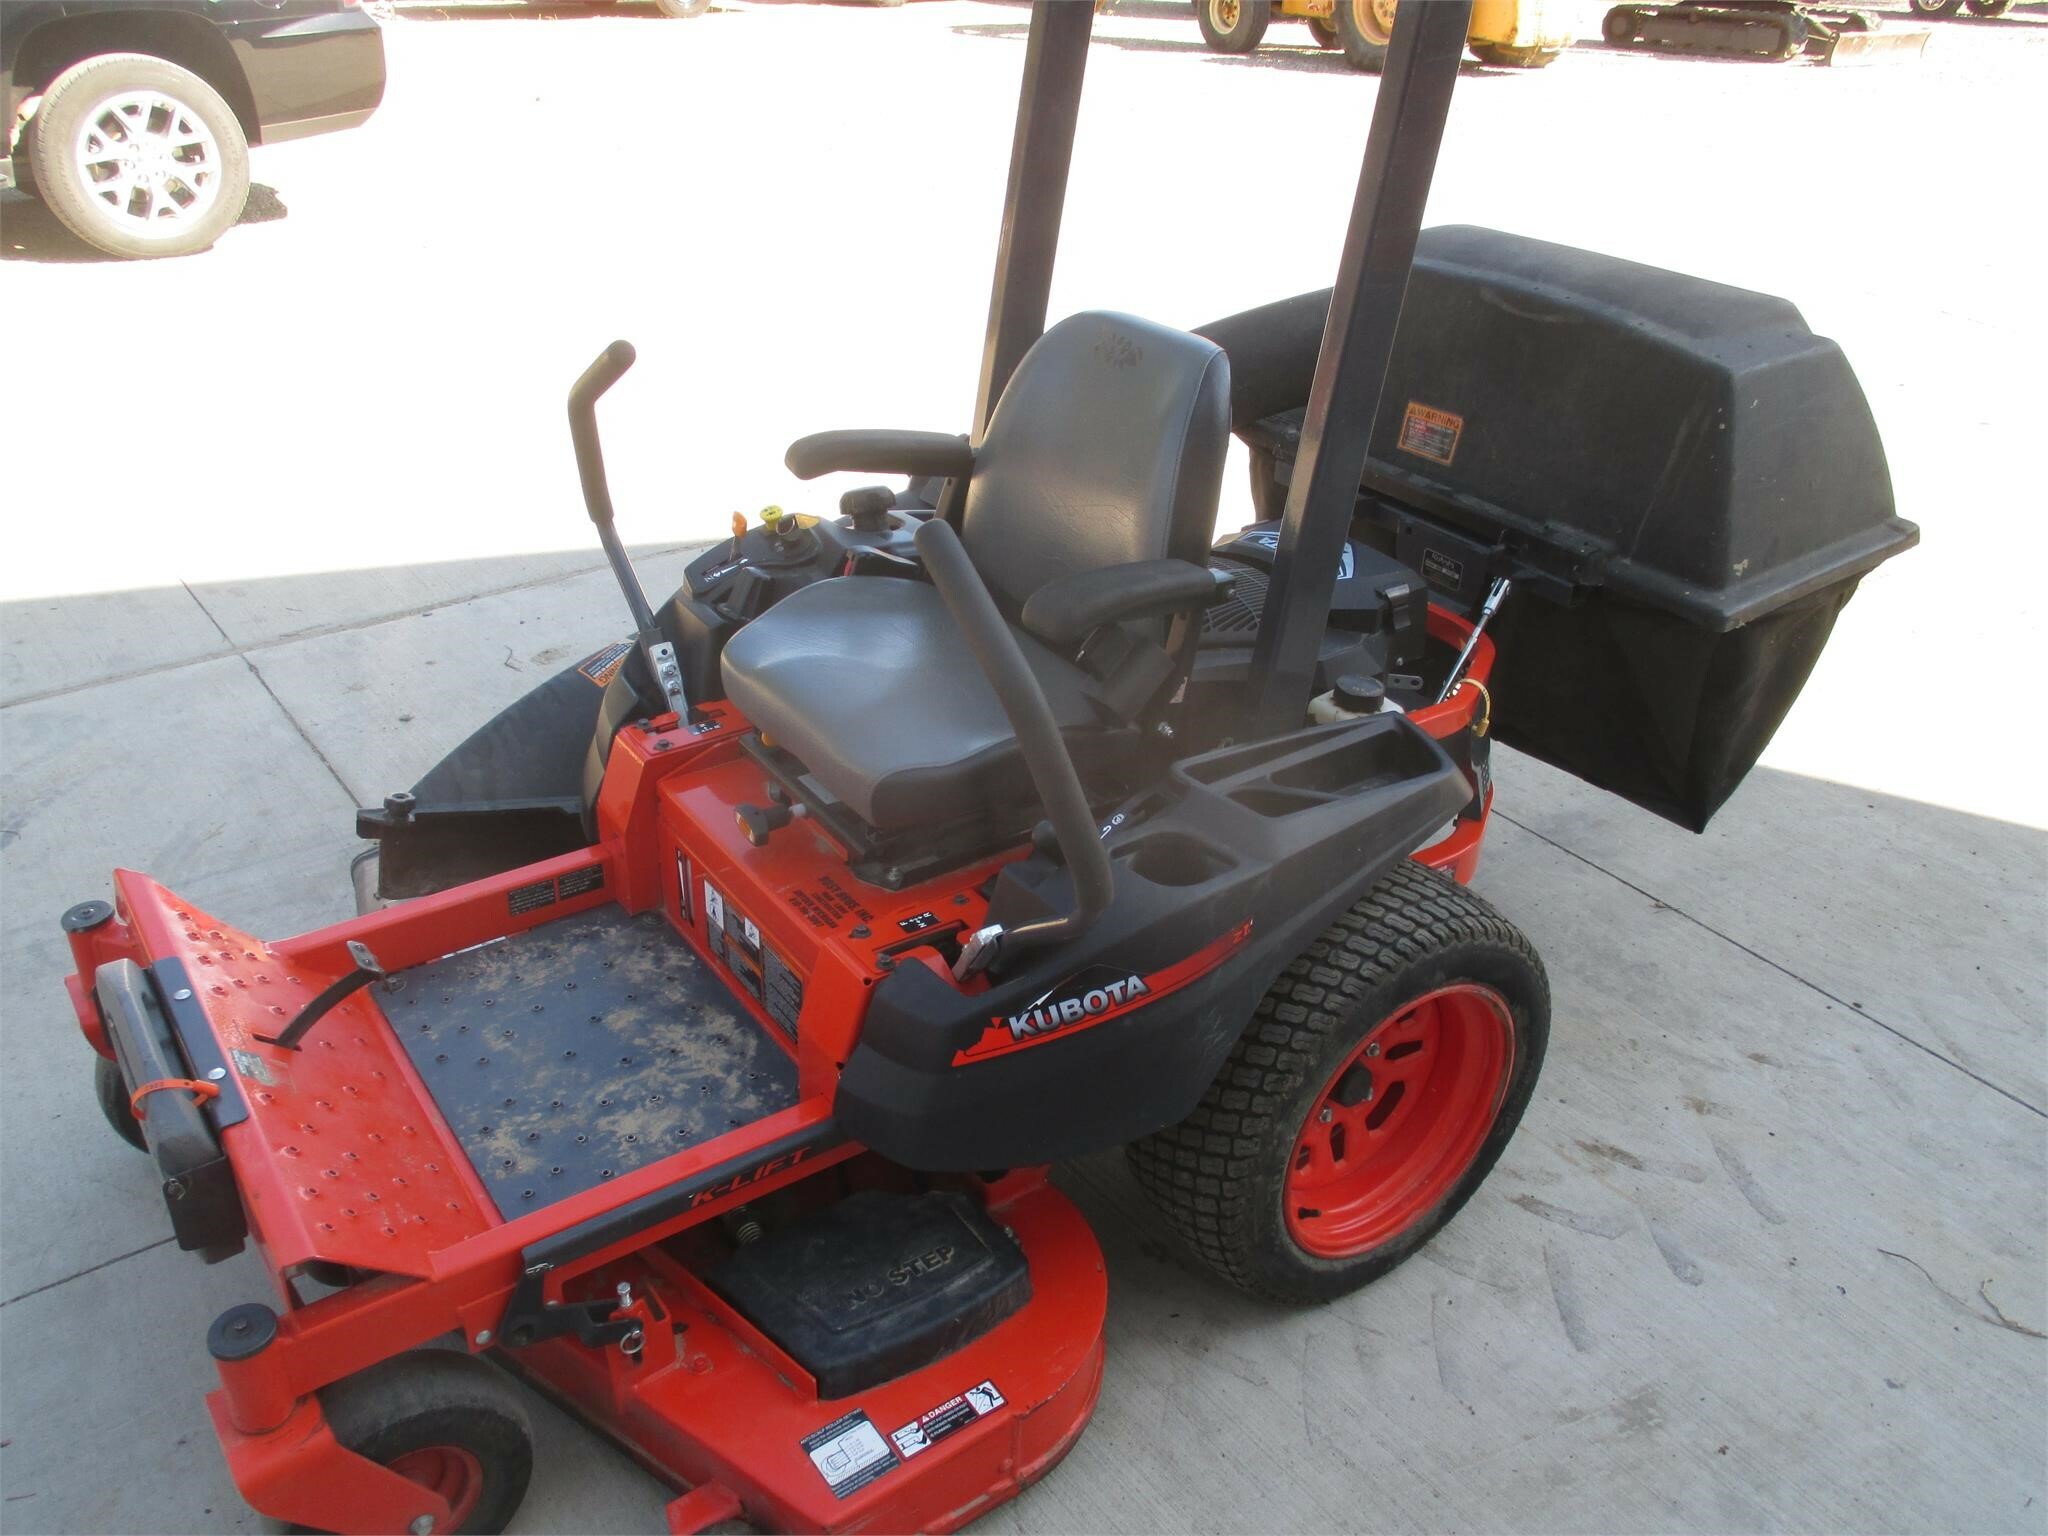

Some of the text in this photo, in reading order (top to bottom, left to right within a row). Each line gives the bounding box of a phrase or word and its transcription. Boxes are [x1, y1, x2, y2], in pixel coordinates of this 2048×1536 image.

[1416, 405, 1460, 429] WARNING
[1008, 975, 1150, 1041] KUBOTA
[690, 1146, 812, 1208] K-LIFT
[848, 1246, 955, 1310] NO STEP
[928, 1396, 963, 1418] DANGER
